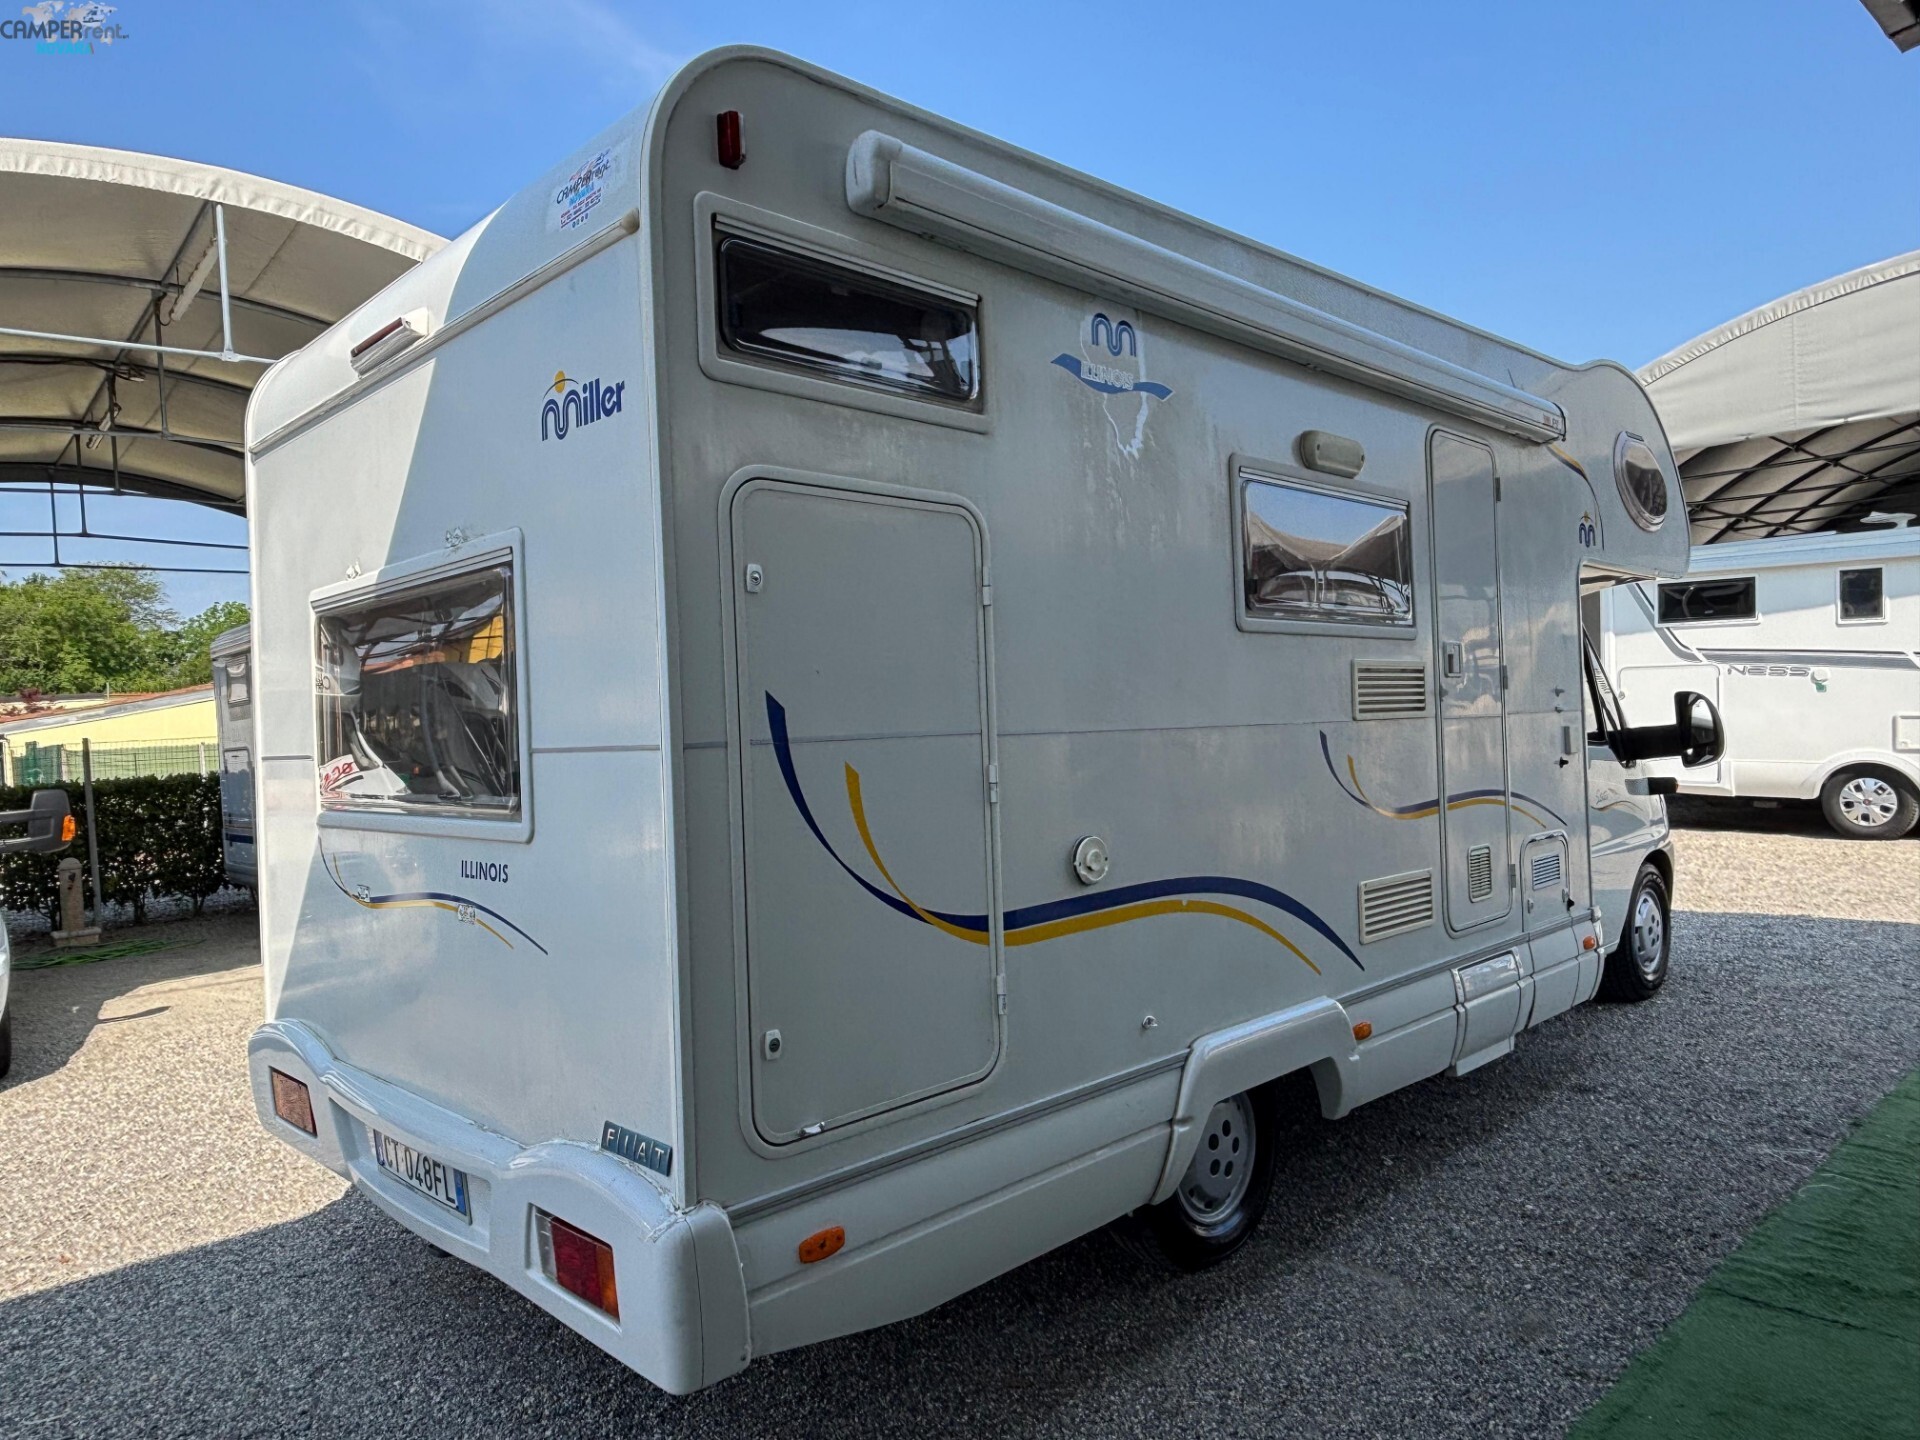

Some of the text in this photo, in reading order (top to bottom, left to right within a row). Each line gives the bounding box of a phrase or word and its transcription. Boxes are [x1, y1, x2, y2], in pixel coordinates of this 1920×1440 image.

[1080, 360, 1134, 391] ILLINOIS
[541, 377, 625, 441] Miller
[461, 859, 509, 883] ILLINOIS
[606, 1128, 665, 1169] FIAT
